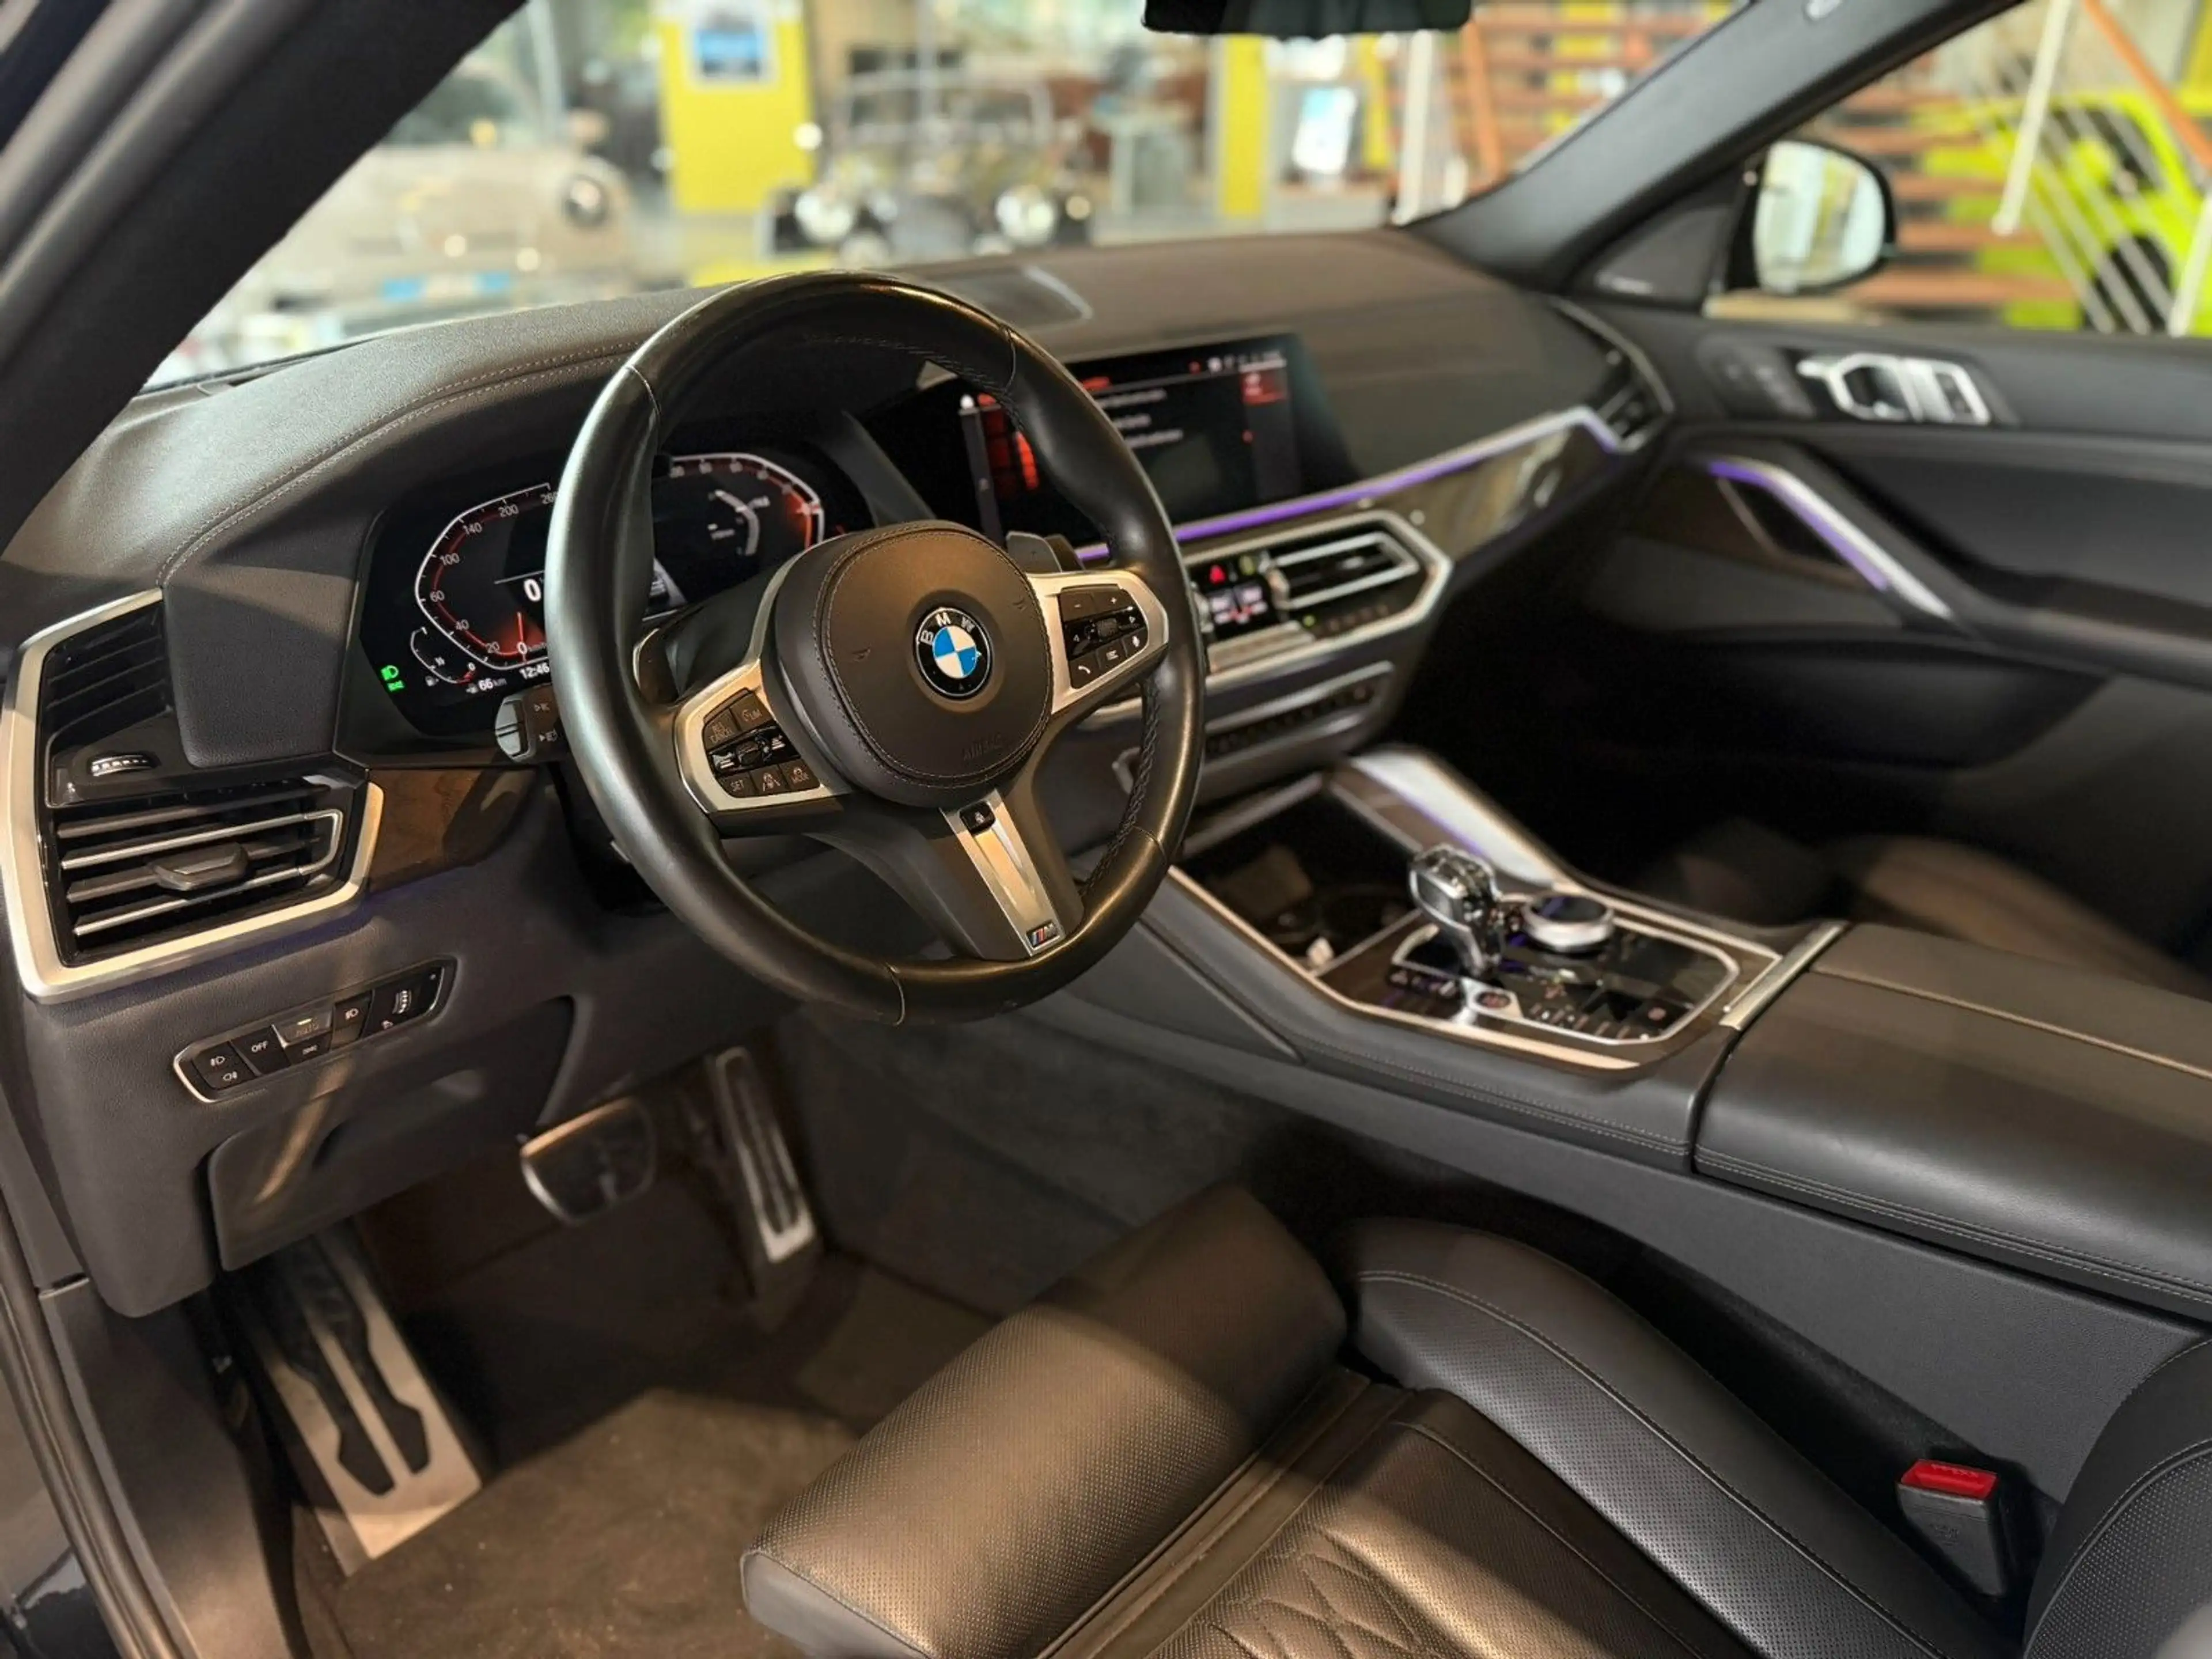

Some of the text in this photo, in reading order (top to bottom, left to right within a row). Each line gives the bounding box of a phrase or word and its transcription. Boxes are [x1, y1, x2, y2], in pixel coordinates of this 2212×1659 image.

[499, 504, 519, 518] 200
[463, 522, 483, 535] 140
[440, 553, 460, 566] 100
[430, 590, 445, 603] 60
[523, 578, 542, 602] 0
[456, 619, 470, 630] 40
[920, 612, 976, 646] BMW
[485, 641, 500, 653] 20
[520, 662, 550, 680] 12:46
[478, 678, 494, 691] 66
[730, 779, 745, 792] SET
[251, 1040, 269, 1054] OFF
